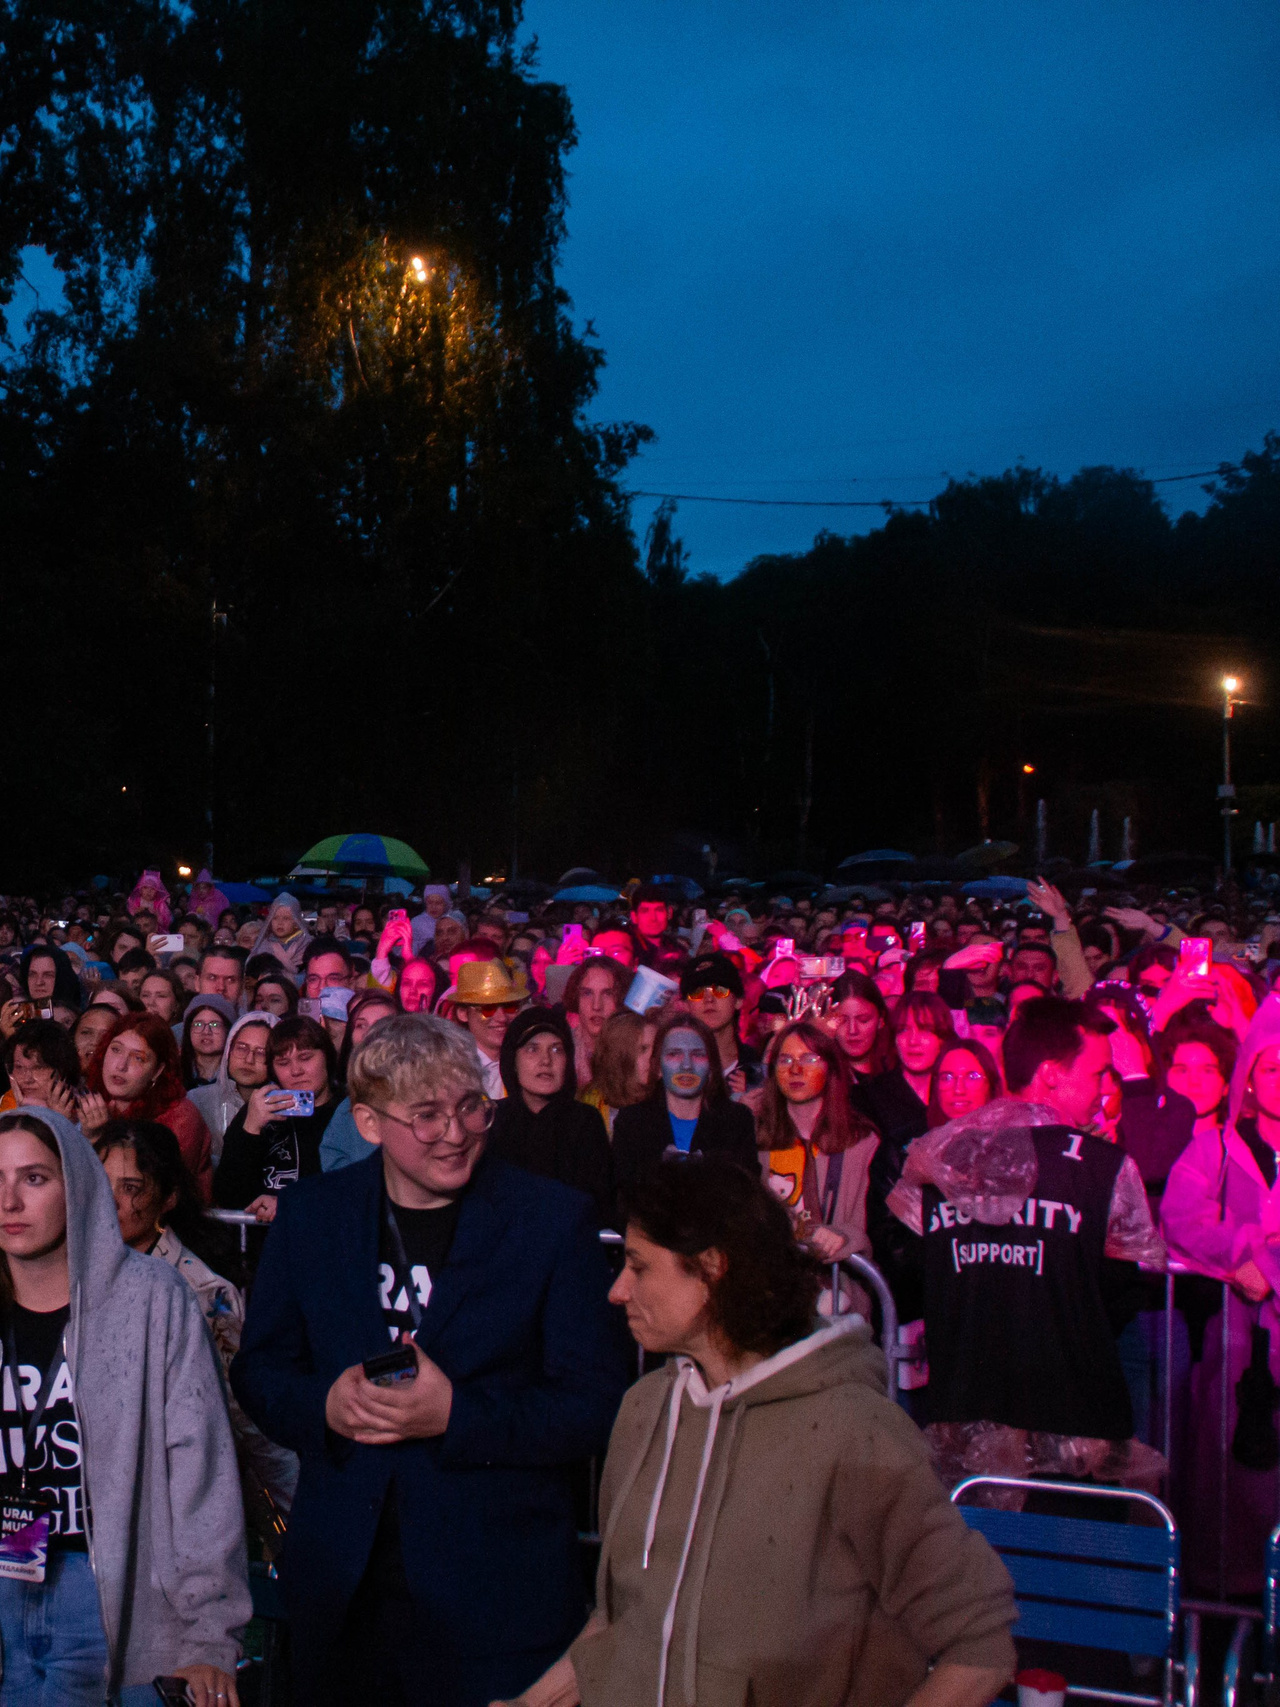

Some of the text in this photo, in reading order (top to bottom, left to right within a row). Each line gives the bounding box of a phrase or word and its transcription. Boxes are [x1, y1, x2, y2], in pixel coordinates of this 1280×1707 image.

[1061, 1133, 1084, 1161] 1
[378, 1262, 433, 1311] RA
[2, 1361, 74, 1412] RA
[2, 1506, 35, 1521] URAL
